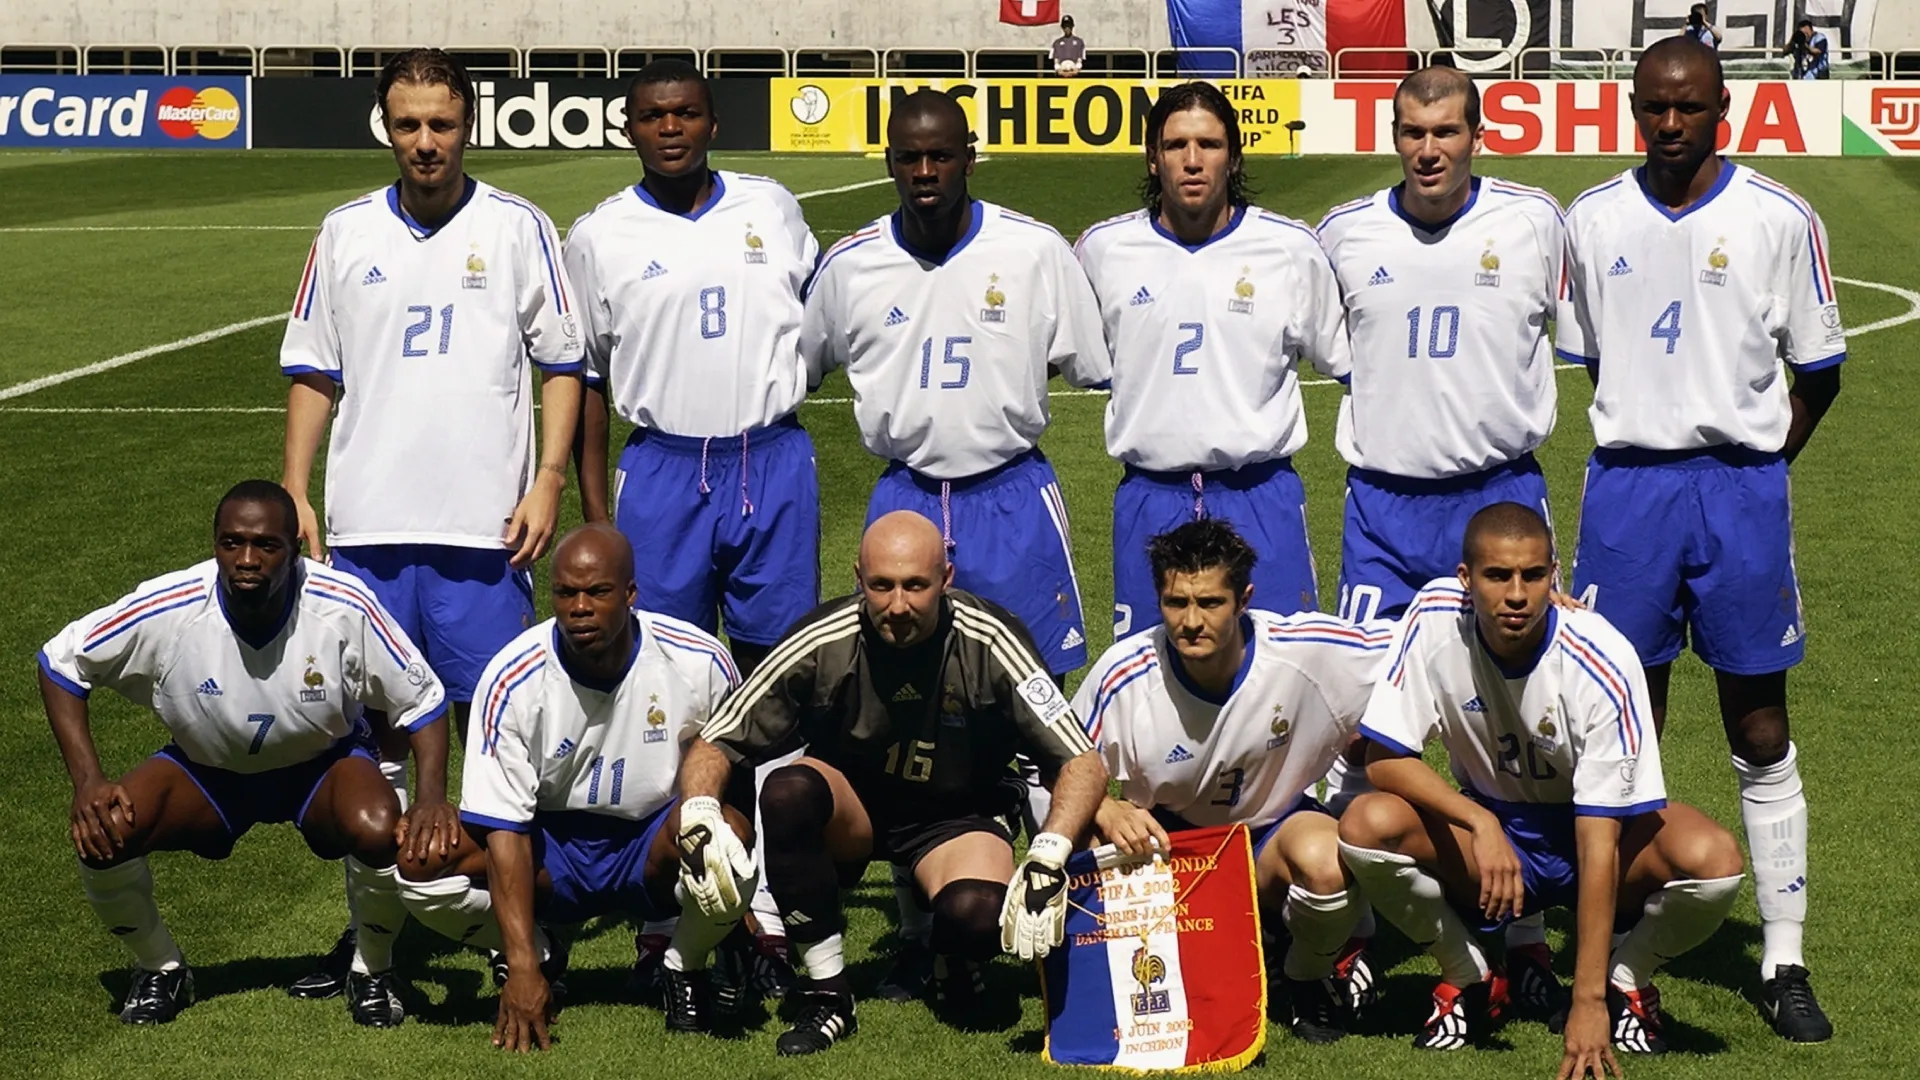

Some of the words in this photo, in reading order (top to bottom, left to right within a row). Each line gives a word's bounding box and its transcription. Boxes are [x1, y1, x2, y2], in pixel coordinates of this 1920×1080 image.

[1267, 8, 1311, 28] LES
[1277, 28, 1295, 45] 3
[158, 105, 238, 121] MasterCard
[370, 81, 636, 149] idas
[866, 85, 1178, 146] IHEON
[1233, 108, 1279, 124] RLD
[1334, 81, 1807, 155] TSHA
[402, 303, 454, 357] 21
[700, 285, 727, 339] 8
[1407, 305, 1460, 358] 10
[1650, 300, 1682, 354] 4
[920, 336, 972, 389] 15
[1173, 322, 1204, 374] 2
[247, 714, 275, 755] 7
[587, 755, 625, 805] 11
[884, 739, 935, 782] 16
[1211, 767, 1245, 806] 3
[1153, 855, 1218, 875] MONDE
[1096, 883, 1136, 902] FIFA
[1143, 878, 1181, 896] 2002
[1155, 917, 1214, 934] FRANCE
[1128, 1021, 1161, 1037] JUIN
[1166, 1018, 1194, 1034] 2002
